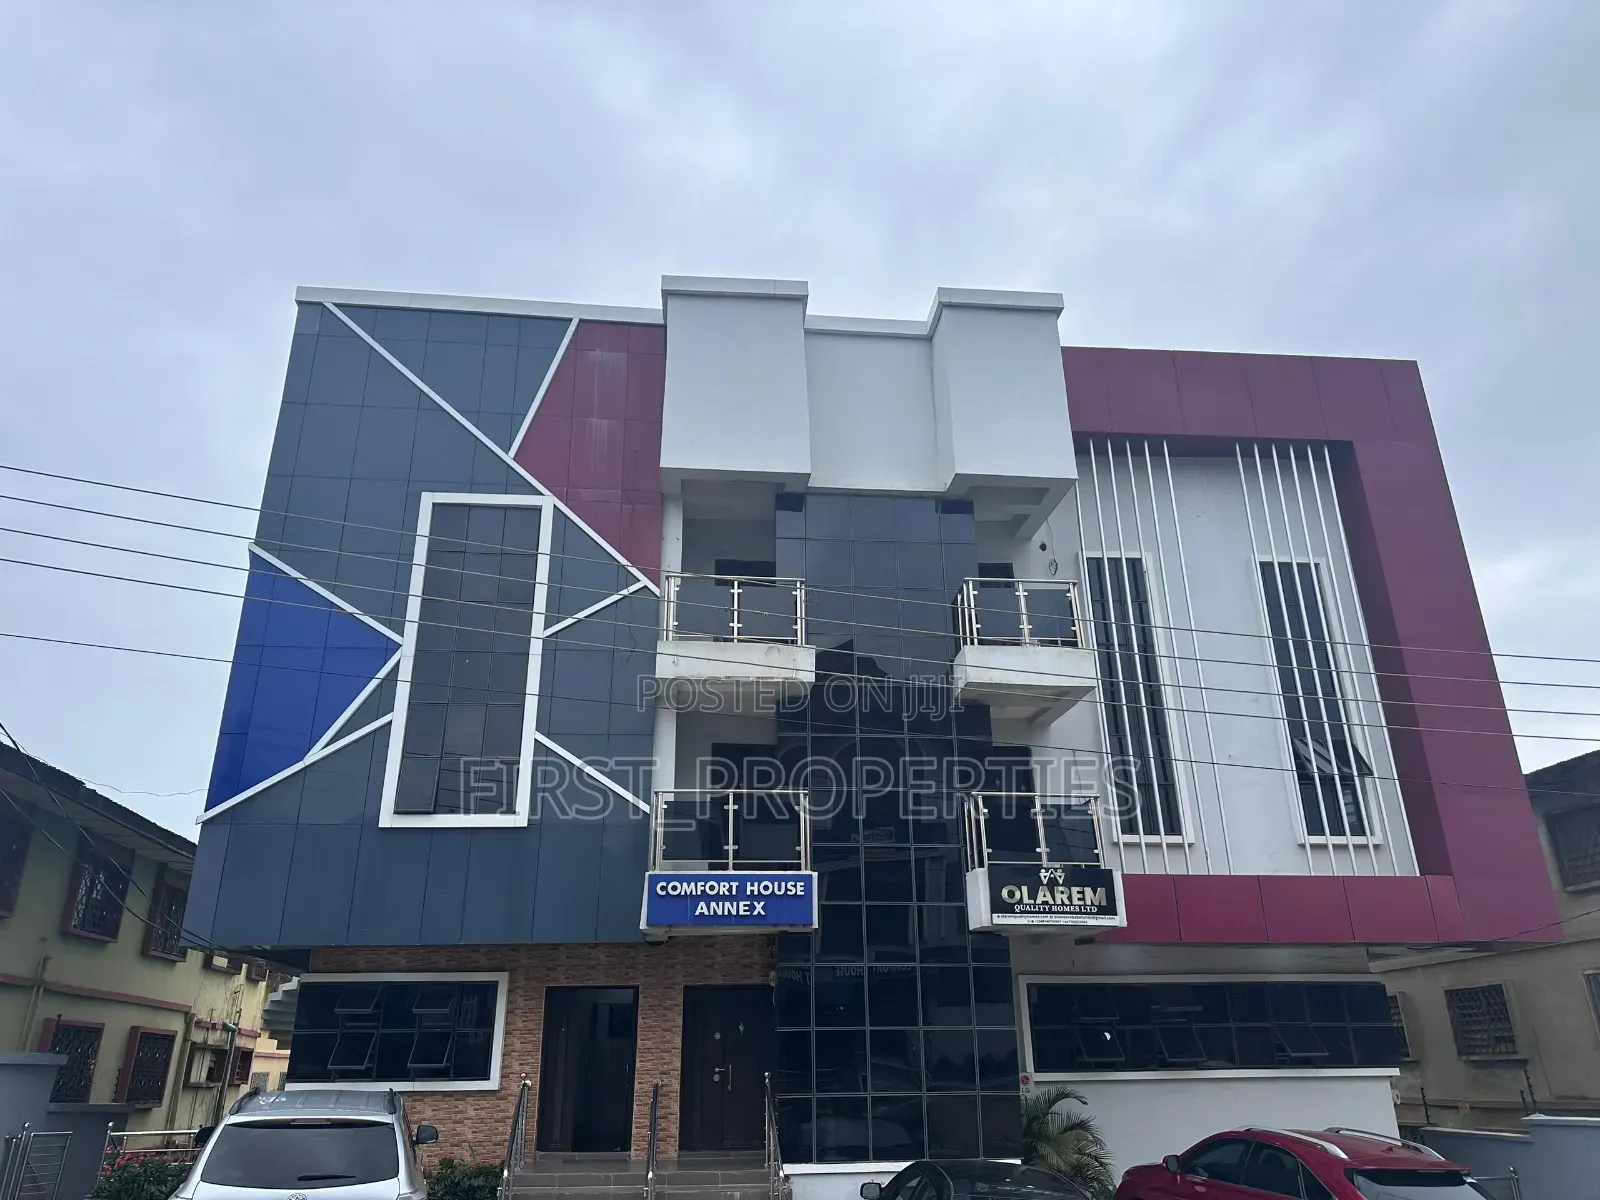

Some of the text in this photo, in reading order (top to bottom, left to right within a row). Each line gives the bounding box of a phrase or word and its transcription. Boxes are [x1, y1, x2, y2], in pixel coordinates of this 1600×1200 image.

[656, 881, 805, 895] COMFORT HOUSE
[1001, 885, 1107, 905] OLAREM
[695, 901, 766, 916] ANNEX
[1014, 904, 1098, 913] QUALITY HOMES LTD
